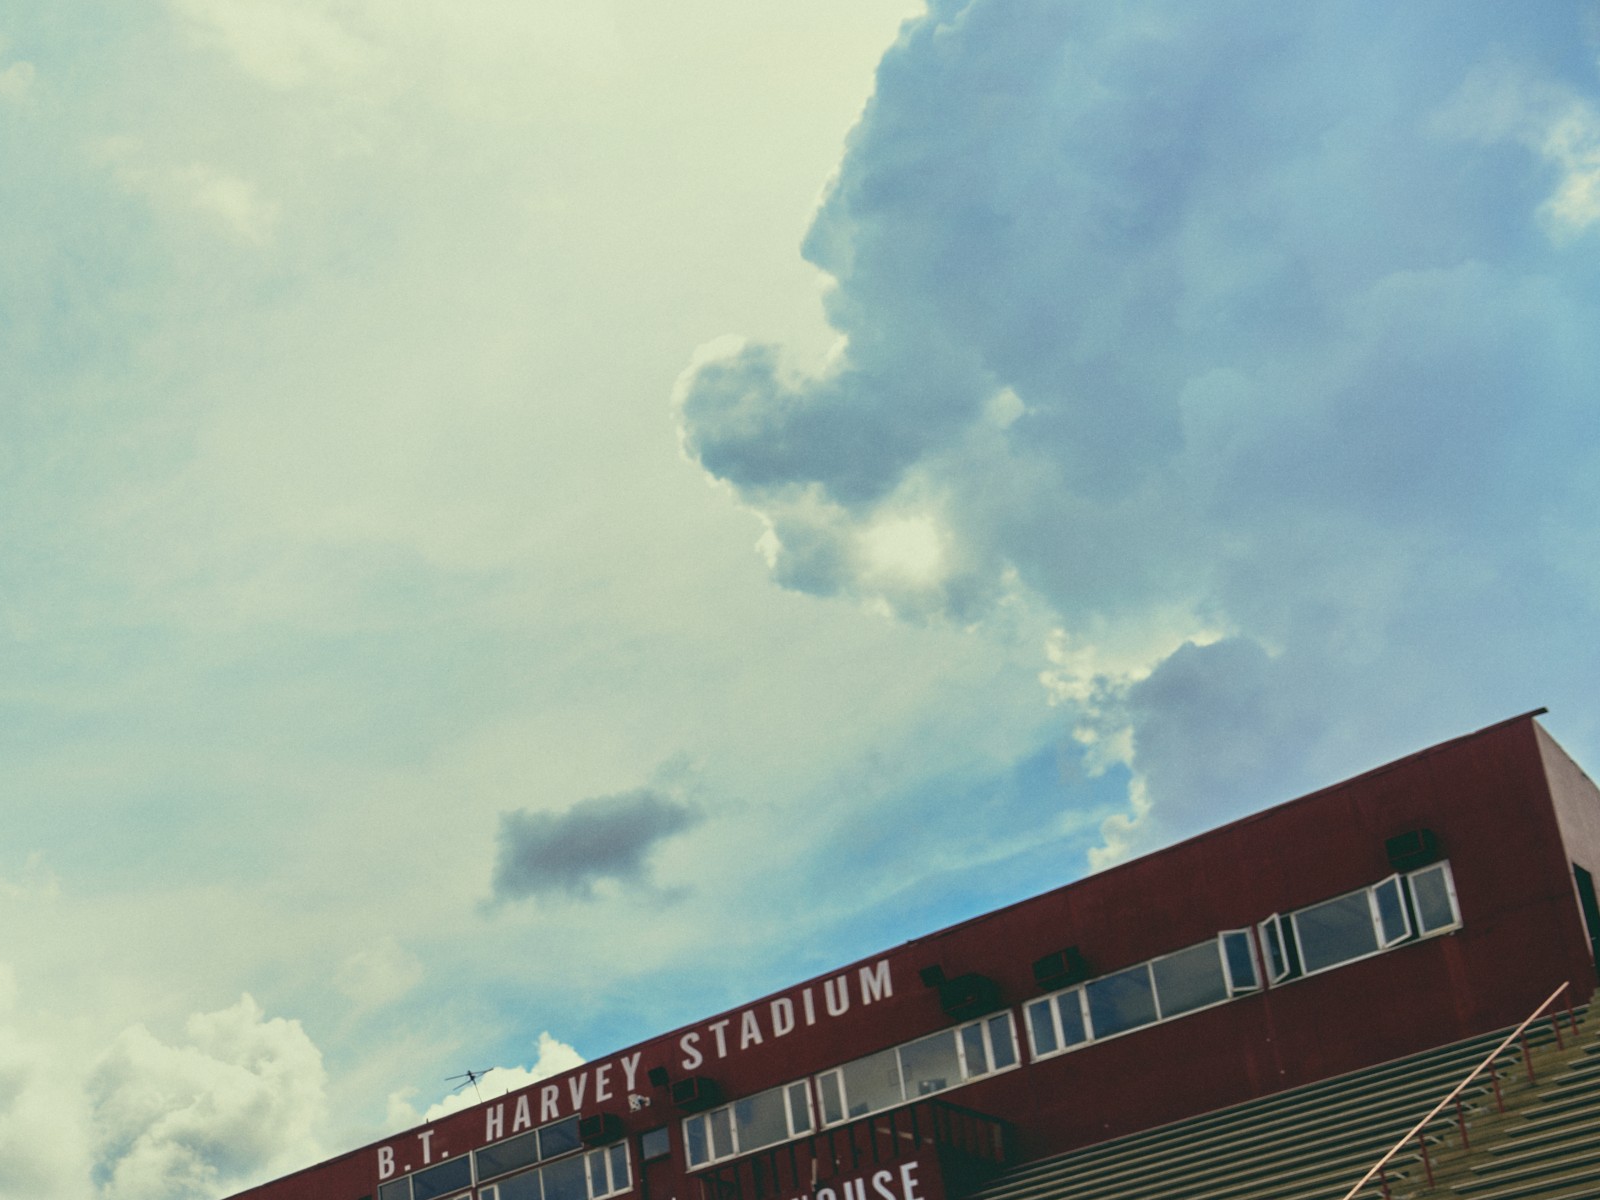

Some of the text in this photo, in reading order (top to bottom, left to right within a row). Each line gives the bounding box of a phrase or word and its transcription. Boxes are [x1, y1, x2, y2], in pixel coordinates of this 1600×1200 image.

[377, 959, 894, 1181] B.T. HARVEY STADIUM
